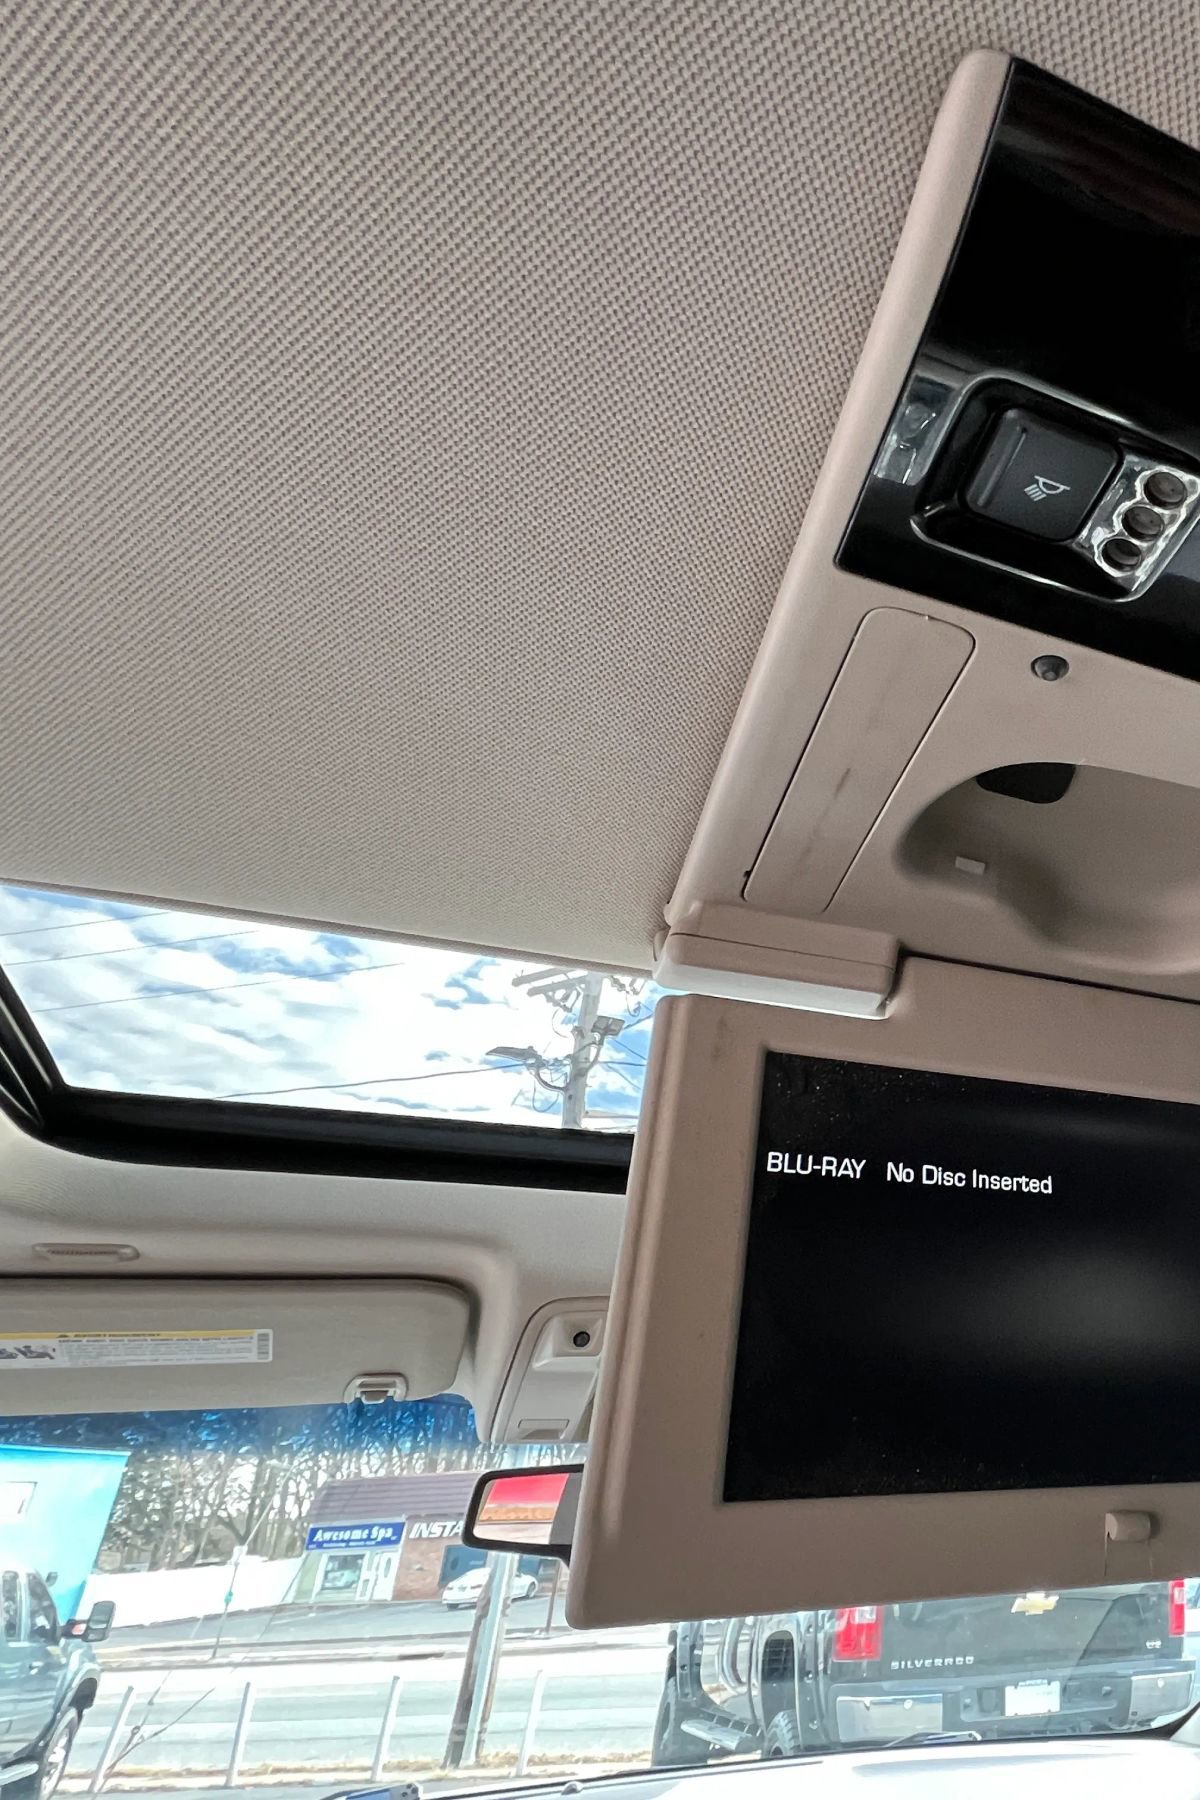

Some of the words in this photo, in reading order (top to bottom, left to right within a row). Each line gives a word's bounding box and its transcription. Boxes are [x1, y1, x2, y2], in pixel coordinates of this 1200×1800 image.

[767, 1151, 867, 1179] BLU-RAY
[886, 1161, 915, 1183] No
[922, 1164, 966, 1187] Disc
[972, 1168, 1053, 1194] Inserted
[313, 1528, 370, 1542] Awesome
[370, 1525, 395, 1542] Spa
[890, 1656, 974, 1670] SILVERADO
